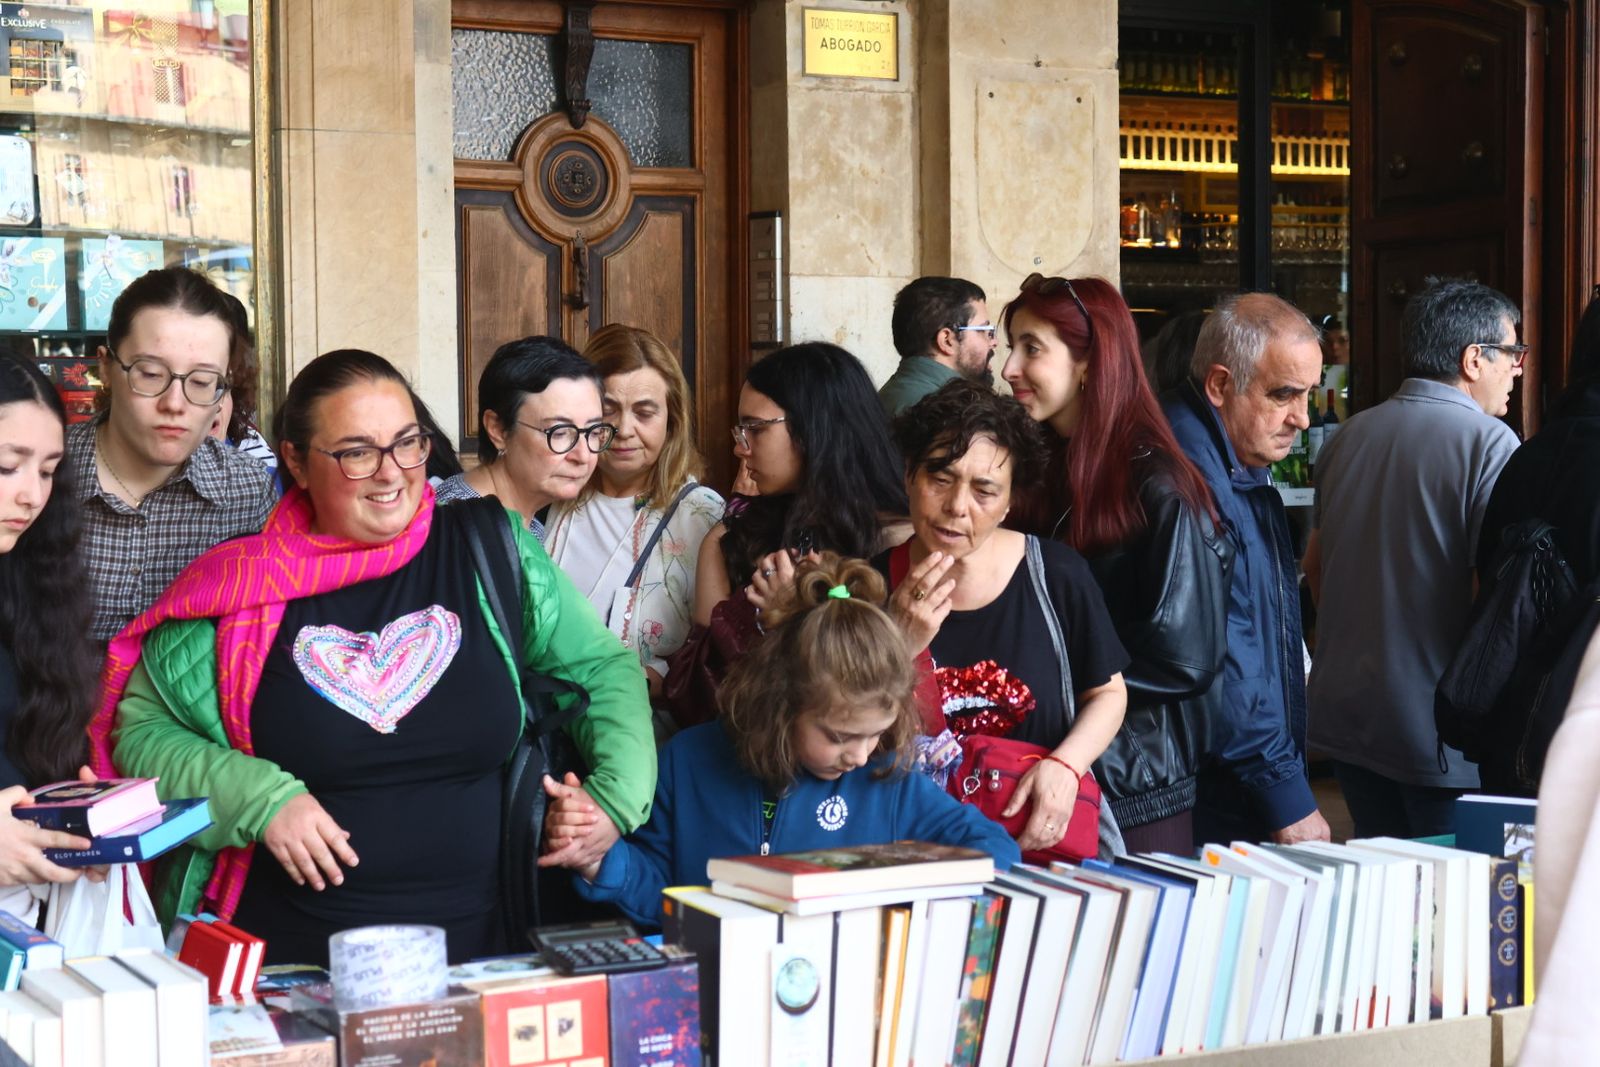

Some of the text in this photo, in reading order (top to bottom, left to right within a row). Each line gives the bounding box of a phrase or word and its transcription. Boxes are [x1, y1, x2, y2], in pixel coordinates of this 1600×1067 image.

[1, 17, 47, 29] EXCLUSIVE
[820, 37, 881, 53] ABOGADO
[54, 852, 73, 860] ELOY
